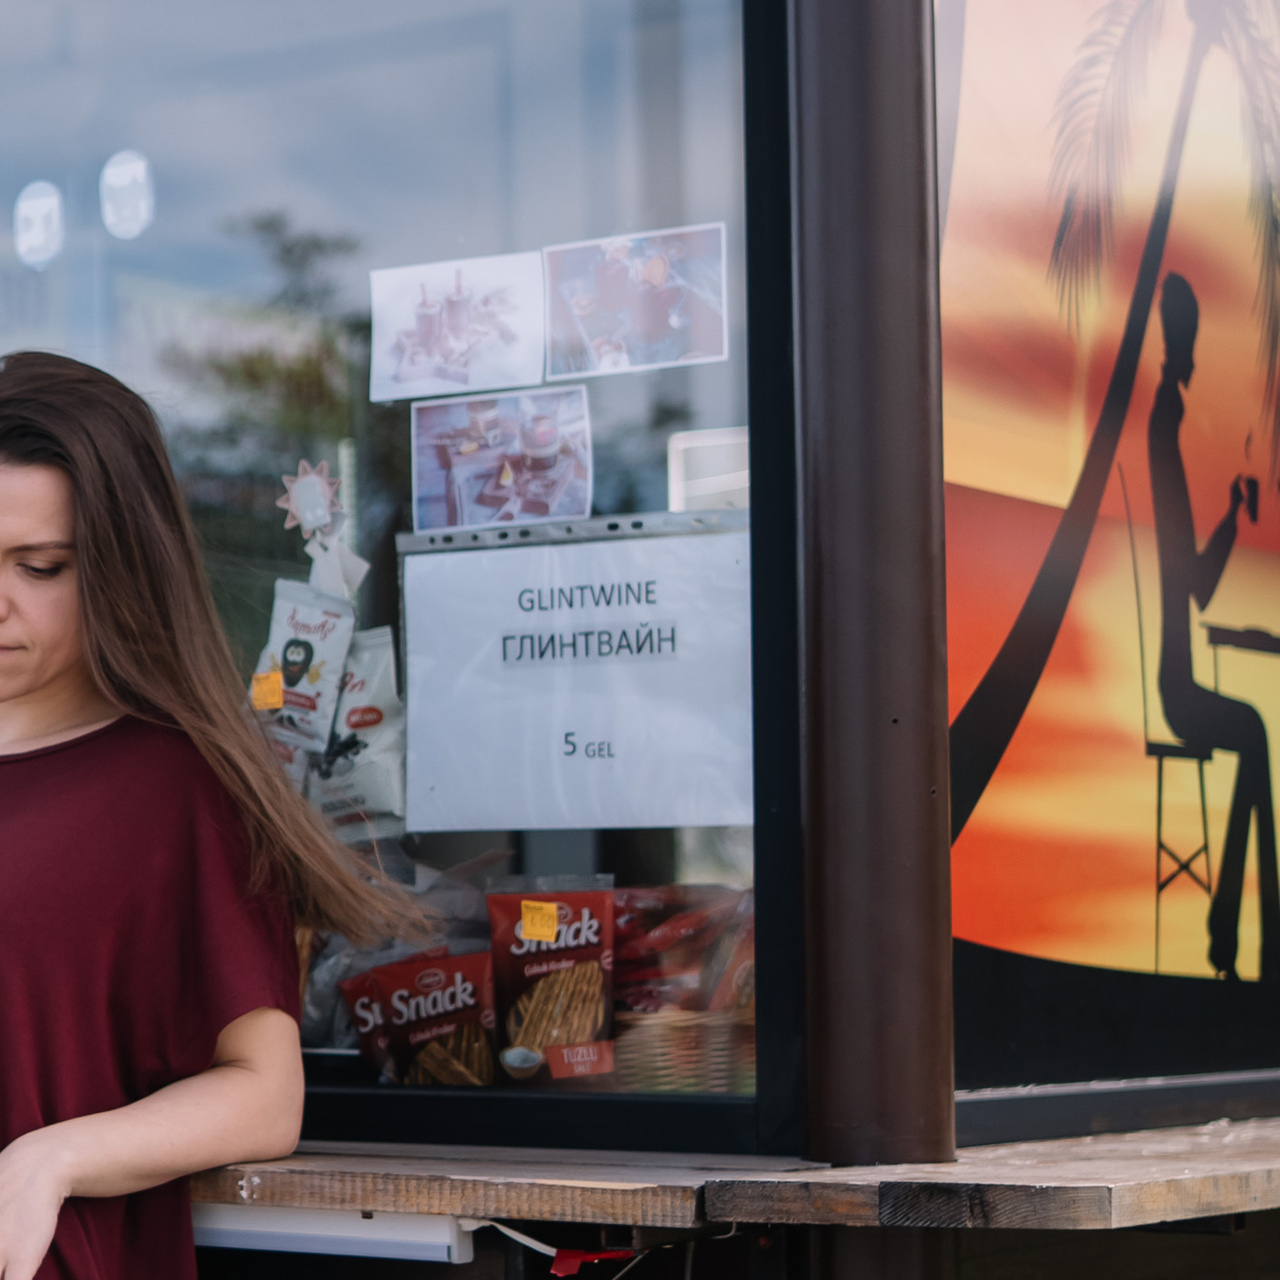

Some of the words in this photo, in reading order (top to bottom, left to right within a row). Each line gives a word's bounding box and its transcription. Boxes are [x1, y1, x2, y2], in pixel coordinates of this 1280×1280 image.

[517, 580, 657, 612] GLINTWINE
[501, 621, 676, 662] ГЛИНТВАЙН
[563, 731, 577, 757] 5
[584, 741, 616, 759] GEL
[391, 972, 476, 1025] Snack
